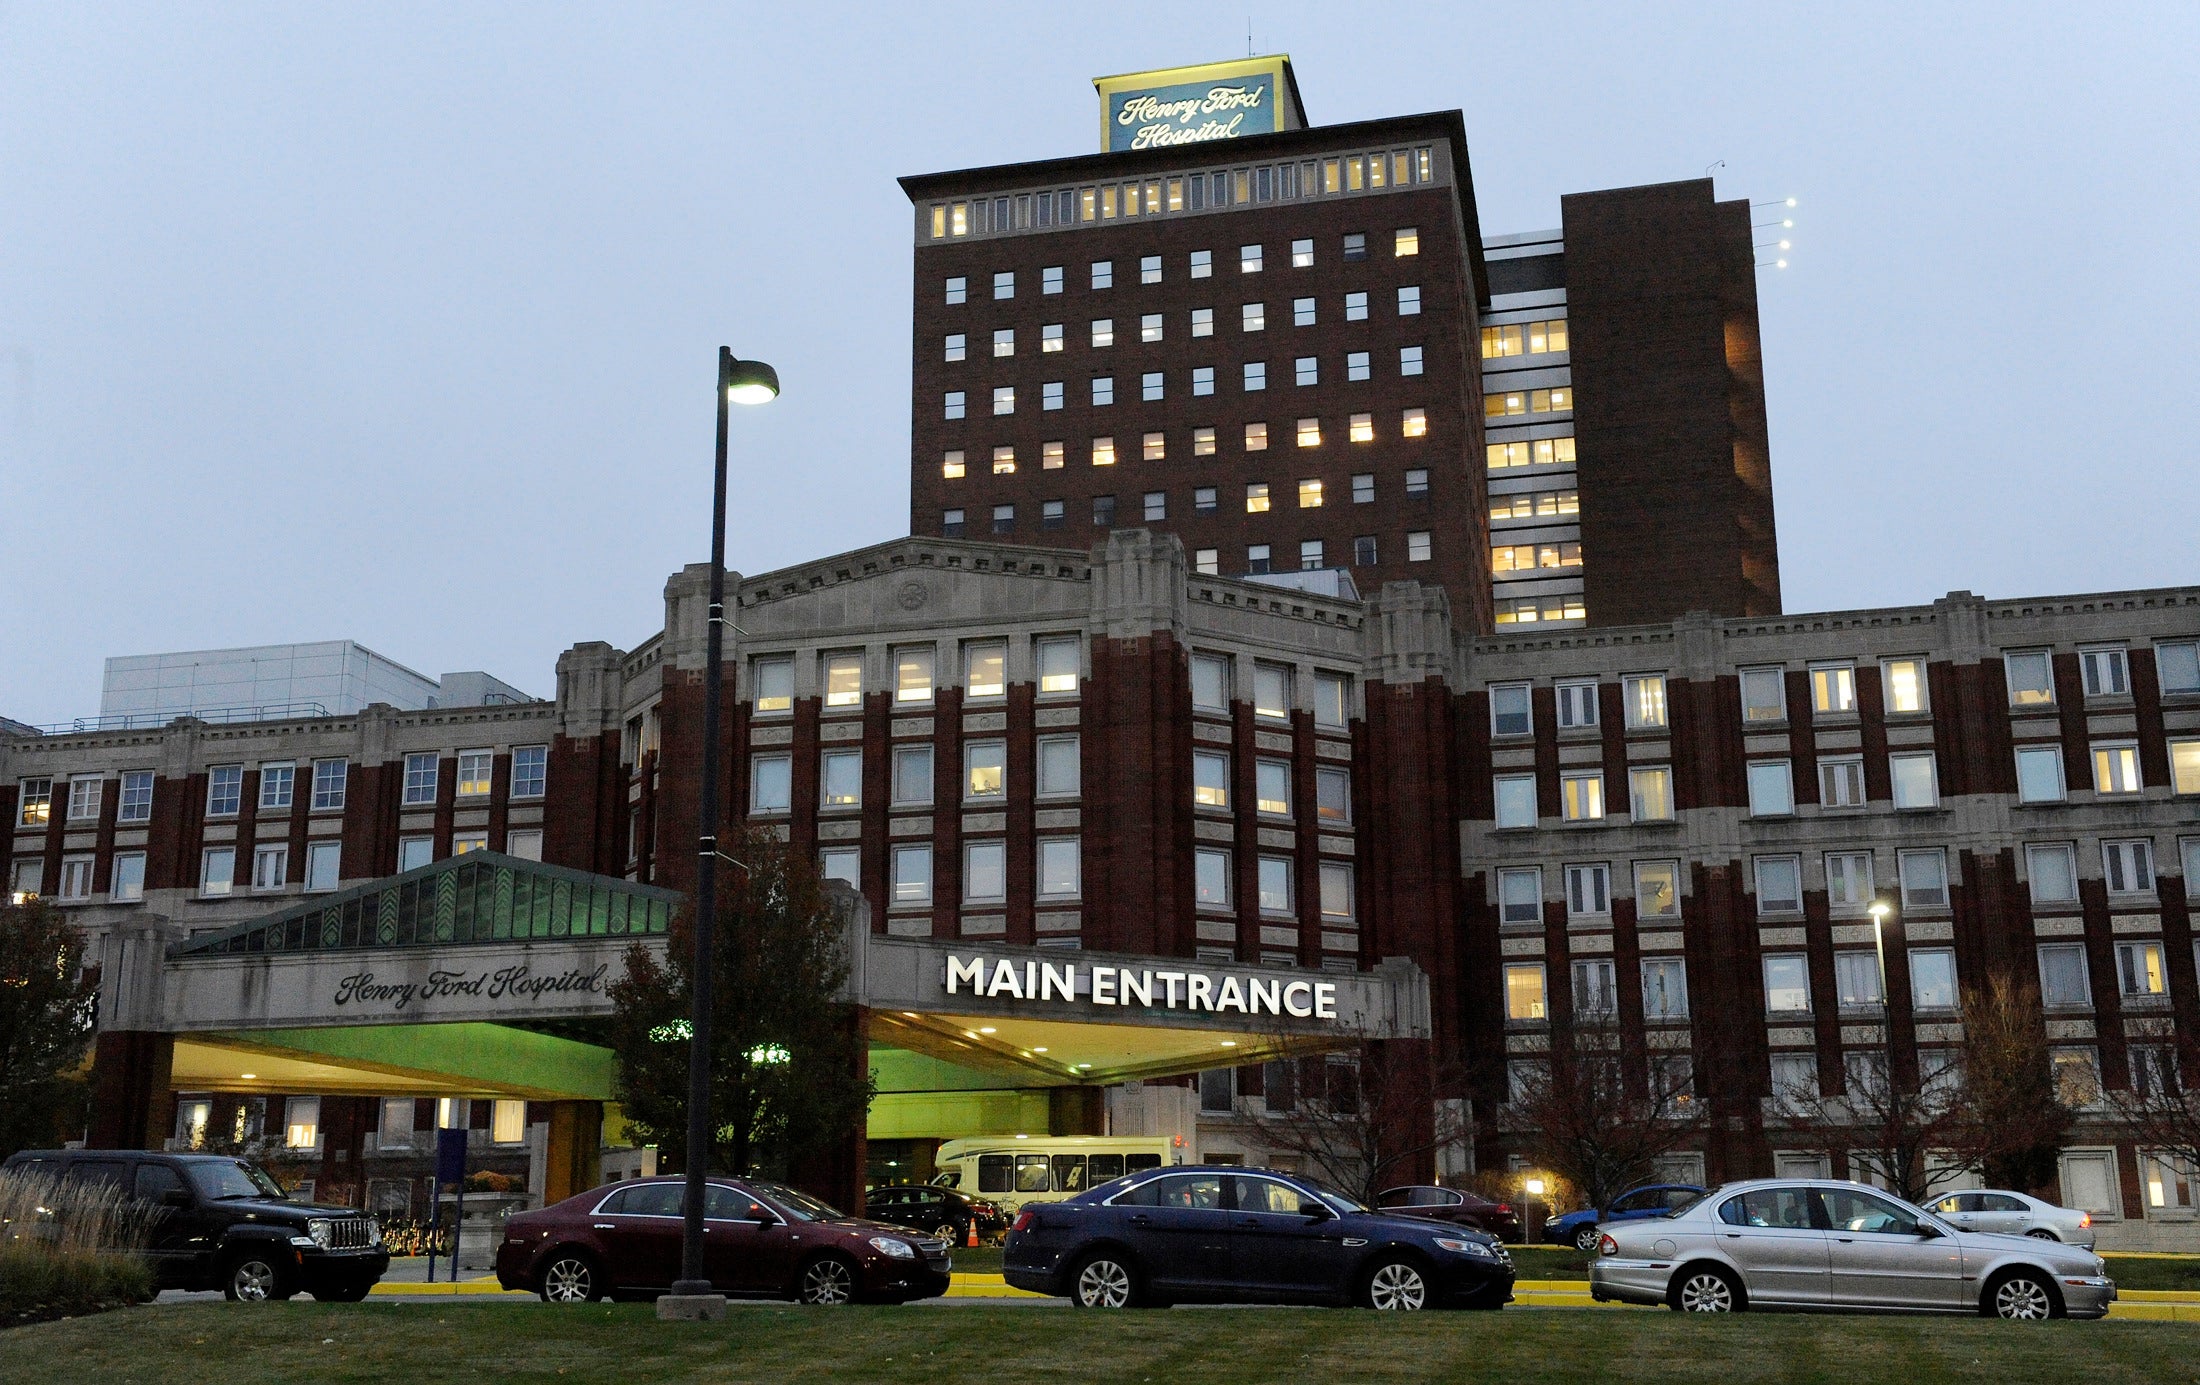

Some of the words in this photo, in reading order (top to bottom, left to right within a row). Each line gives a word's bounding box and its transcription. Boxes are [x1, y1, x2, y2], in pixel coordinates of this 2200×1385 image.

[1118, 95, 1201, 125] Henry
[1201, 85, 1265, 114] Ford
[1131, 112, 1244, 149] Hospital
[334, 973, 418, 1009] Henry
[421, 970, 488, 999] Ford
[488, 963, 608, 1000] Hospital
[946, 955, 1075, 1002] MAIN
[1092, 967, 1337, 1019] ENTRANCE
